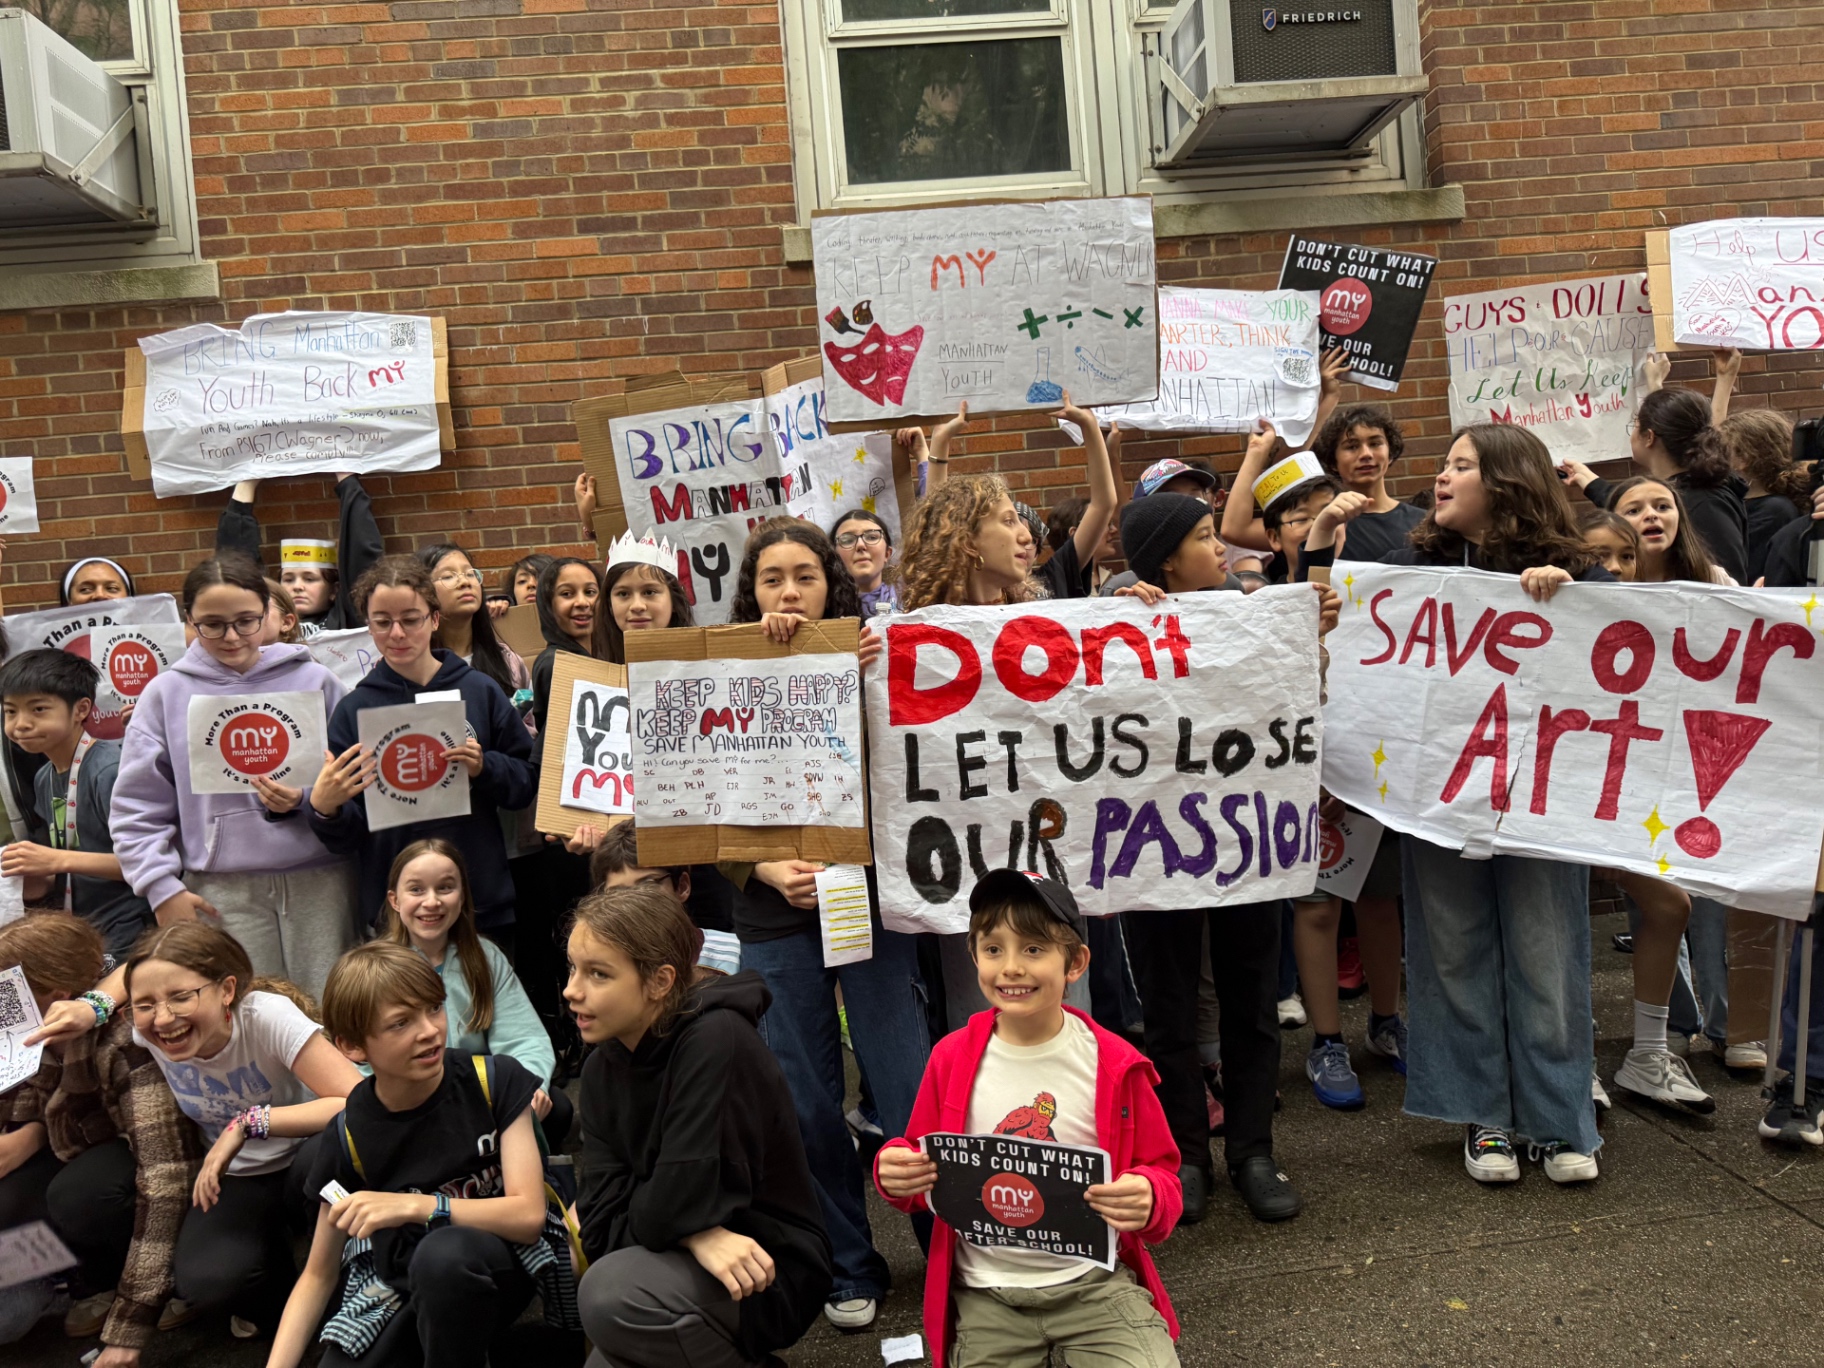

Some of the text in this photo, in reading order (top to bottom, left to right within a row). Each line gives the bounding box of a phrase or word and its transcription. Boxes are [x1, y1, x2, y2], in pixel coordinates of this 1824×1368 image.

[1282, 11, 1361, 23] FRIEDRICH
[1296, 239, 1435, 274] DON'T CUT WHAT
[1691, 230, 1757, 266] Help
[832, 255, 911, 299] KEEP
[930, 248, 997, 291] MY
[1012, 244, 1047, 286] AT
[1296, 256, 1425, 289] KIDS COUNT ON!
[1265, 299, 1313, 322] YOUR
[1323, 307, 1360, 320] manhattan
[1331, 315, 1350, 325] youth
[1444, 296, 1526, 334] GUYS
[1233, 322, 1291, 348] THINK
[184, 321, 380, 375] BRING Manhattan
[939, 342, 1008, 359] MANHATTAN
[1343, 338, 1372, 356] OUR
[1448, 327, 1529, 373] HELP
[1165, 349, 1207, 372] AND
[198, 370, 274, 415] Youth
[304, 361, 358, 401] Back
[1466, 358, 1634, 403] Let Us Keep
[1574, 392, 1626, 418] Youth
[625, 389, 829, 480] BRING BACK
[199, 442, 235, 459] From
[649, 461, 813, 525] MANHATTAN
[42, 617, 98, 648] Than a
[101, 645, 110, 670] More
[107, 634, 126, 651] Than
[136, 632, 169, 666] Program
[115, 671, 149, 679] manhattan
[122, 678, 141, 686] youth
[110, 689, 121, 703] It's
[655, 669, 859, 710] KEEP KIDS HAPPY?
[205, 702, 302, 747] More Than a Program
[636, 706, 837, 739] KEEP MY PROGRAM
[232, 747, 278, 756] manhattan
[644, 733, 846, 755] SAVE MANHATTAN YOUTH
[244, 754, 268, 766] youth
[679, 759, 694, 770] you
[904, 712, 1318, 803] LET US LOSE
[222, 767, 241, 784] It's
[440, 773, 455, 788] It's
[389, 793, 418, 806] More
[705, 792, 716, 801] AP
[705, 803, 721, 816] JD
[906, 797, 1068, 904] OUR
[933, 1136, 1096, 1170] DON'T CUT WHAT
[940, 1150, 1091, 1184] KIDS COUNT ON!
[992, 1203, 1034, 1214] manhattan
[1003, 1210, 1025, 1219] youth
[972, 1220, 1061, 1241] SAVE OUR
